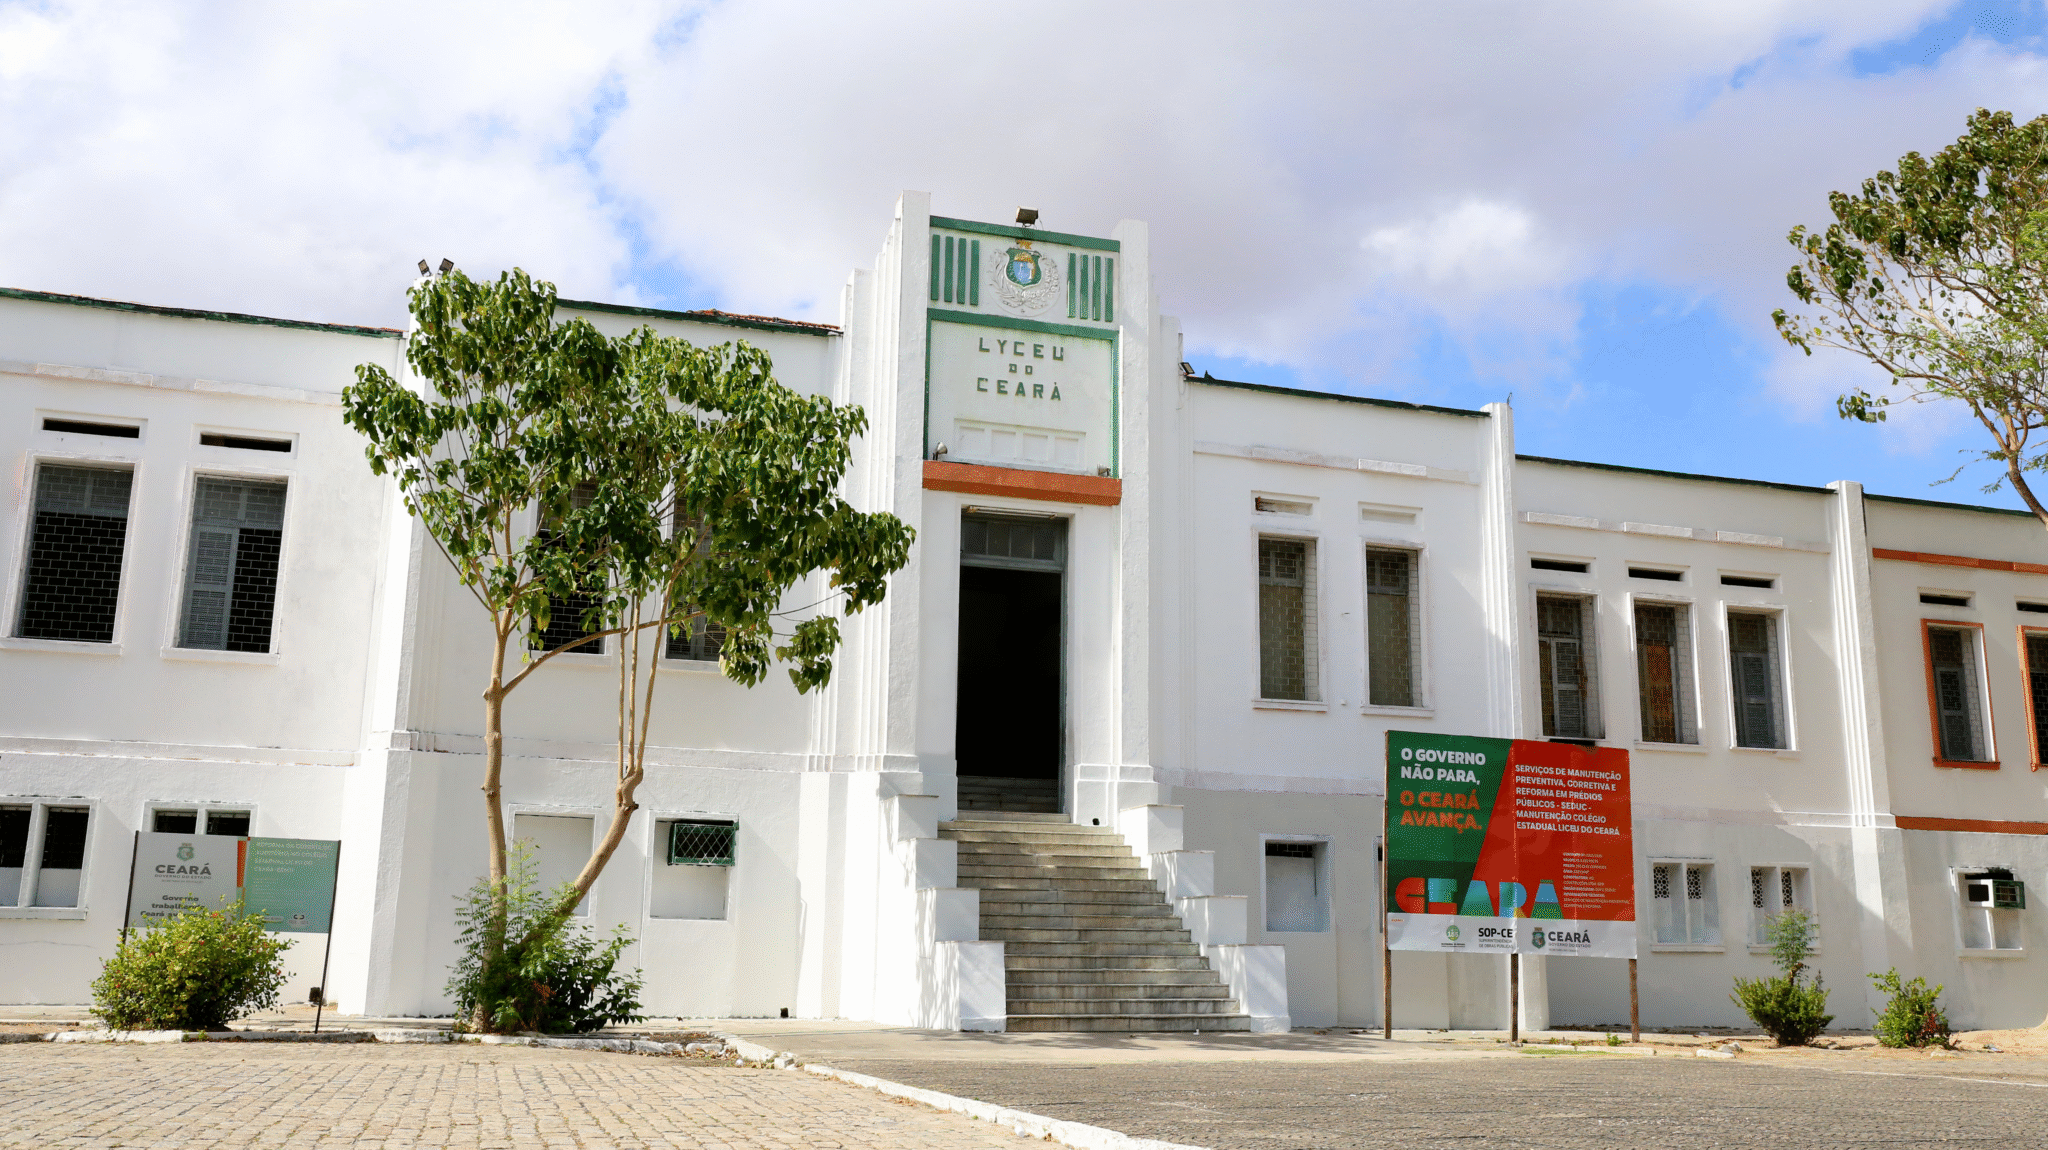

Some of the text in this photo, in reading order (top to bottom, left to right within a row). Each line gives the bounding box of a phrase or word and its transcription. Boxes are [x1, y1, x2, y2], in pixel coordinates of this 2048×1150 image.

[978, 337, 1064, 362] LYCEU
[1008, 363, 1033, 375] DO
[976, 377, 1061, 401] CEARÁ
[1401, 748, 1486, 766] O GOVERNO
[1400, 763, 1480, 786] NÃO PARA,
[1515, 764, 1621, 781] SERVIÇOS DE MANUTENÇÃO
[1515, 775, 1616, 791] PREVENTIVA, CORRETIVA E
[1400, 788, 1480, 811] O CEARÁ
[1515, 787, 1603, 801] REFORMA EM PRÉDIOS
[1515, 797, 1556, 808] PÚBLICOS
[1560, 801, 1588, 810] SEDUC
[1400, 811, 1482, 834] AVANÇA.
[1516, 810, 1606, 823] MANUTENÇÃO COLÉGIO
[1516, 821, 1620, 836] ESTADUAL LICEU DO CEARÁ
[154, 862, 212, 876] CEARÁ
[1478, 928, 1514, 938] SOP-CE
[1547, 929, 1591, 943] CEARÁ
